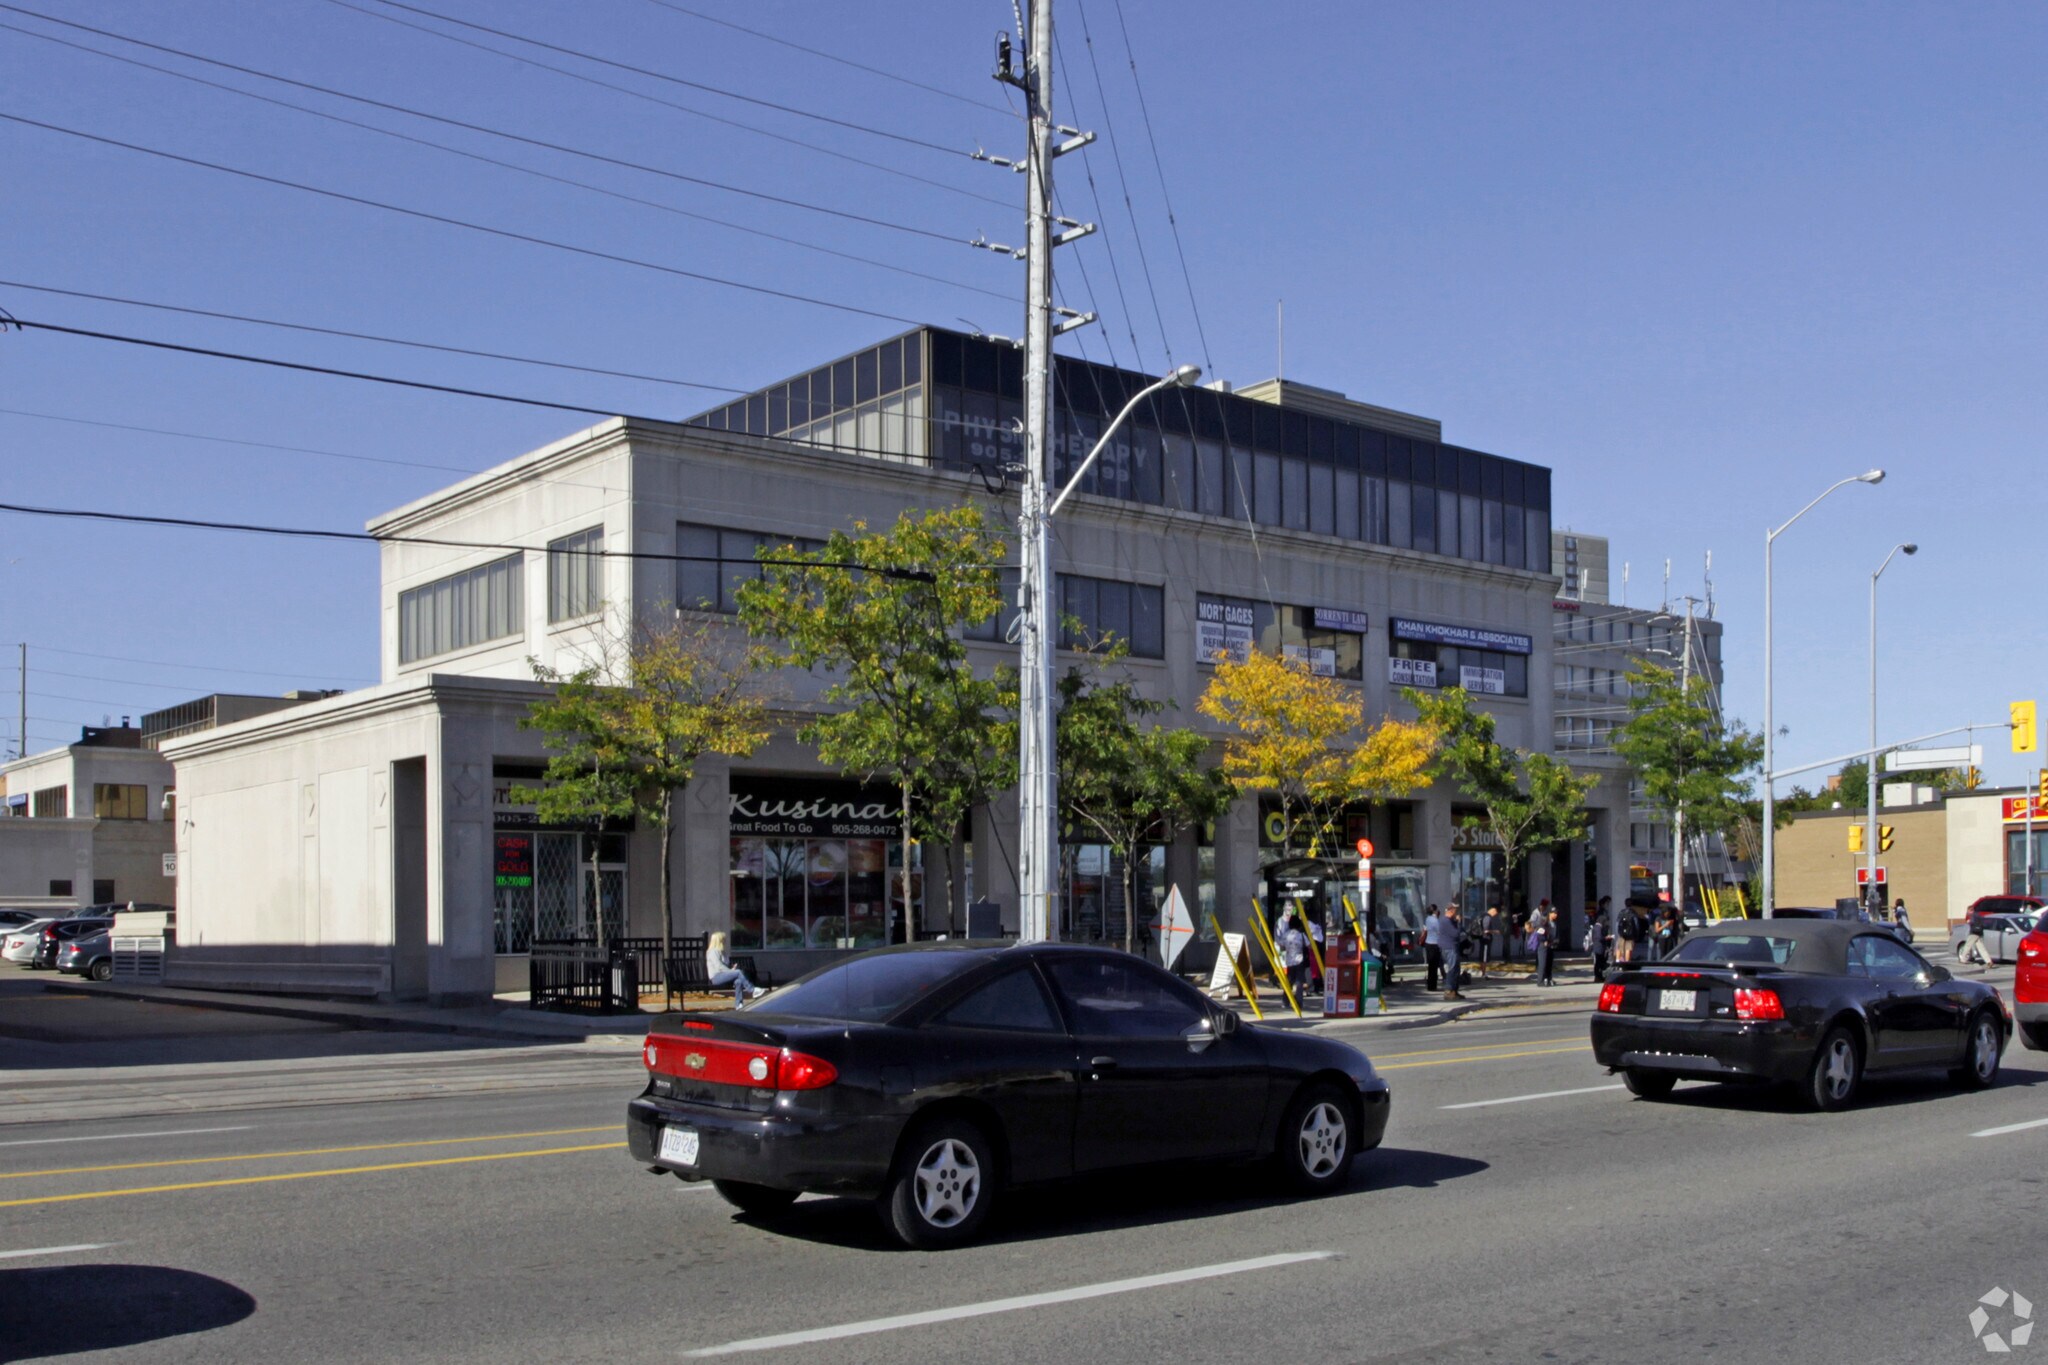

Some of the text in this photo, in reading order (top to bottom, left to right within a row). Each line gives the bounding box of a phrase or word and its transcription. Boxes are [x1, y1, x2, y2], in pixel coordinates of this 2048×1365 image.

[943, 410, 1148, 468] PHYSIHERAPY
[1352, 613, 1366, 624] LAW
[1397, 620, 1529, 646] KHAN KHOKHAR & ASSOCIATES
[1393, 659, 1432, 672] FREE
[729, 793, 899, 819] Kusina
[755, 821, 780, 833] Food
[782, 822, 796, 833] To
[798, 822, 813, 834] Go
[831, 823, 897, 836] 905-268-0472
[497, 837, 529, 849] CASH
[1471, 826, 1502, 846] Store
[165, 862, 176, 871] 10
[497, 861, 529, 873] GOLD
